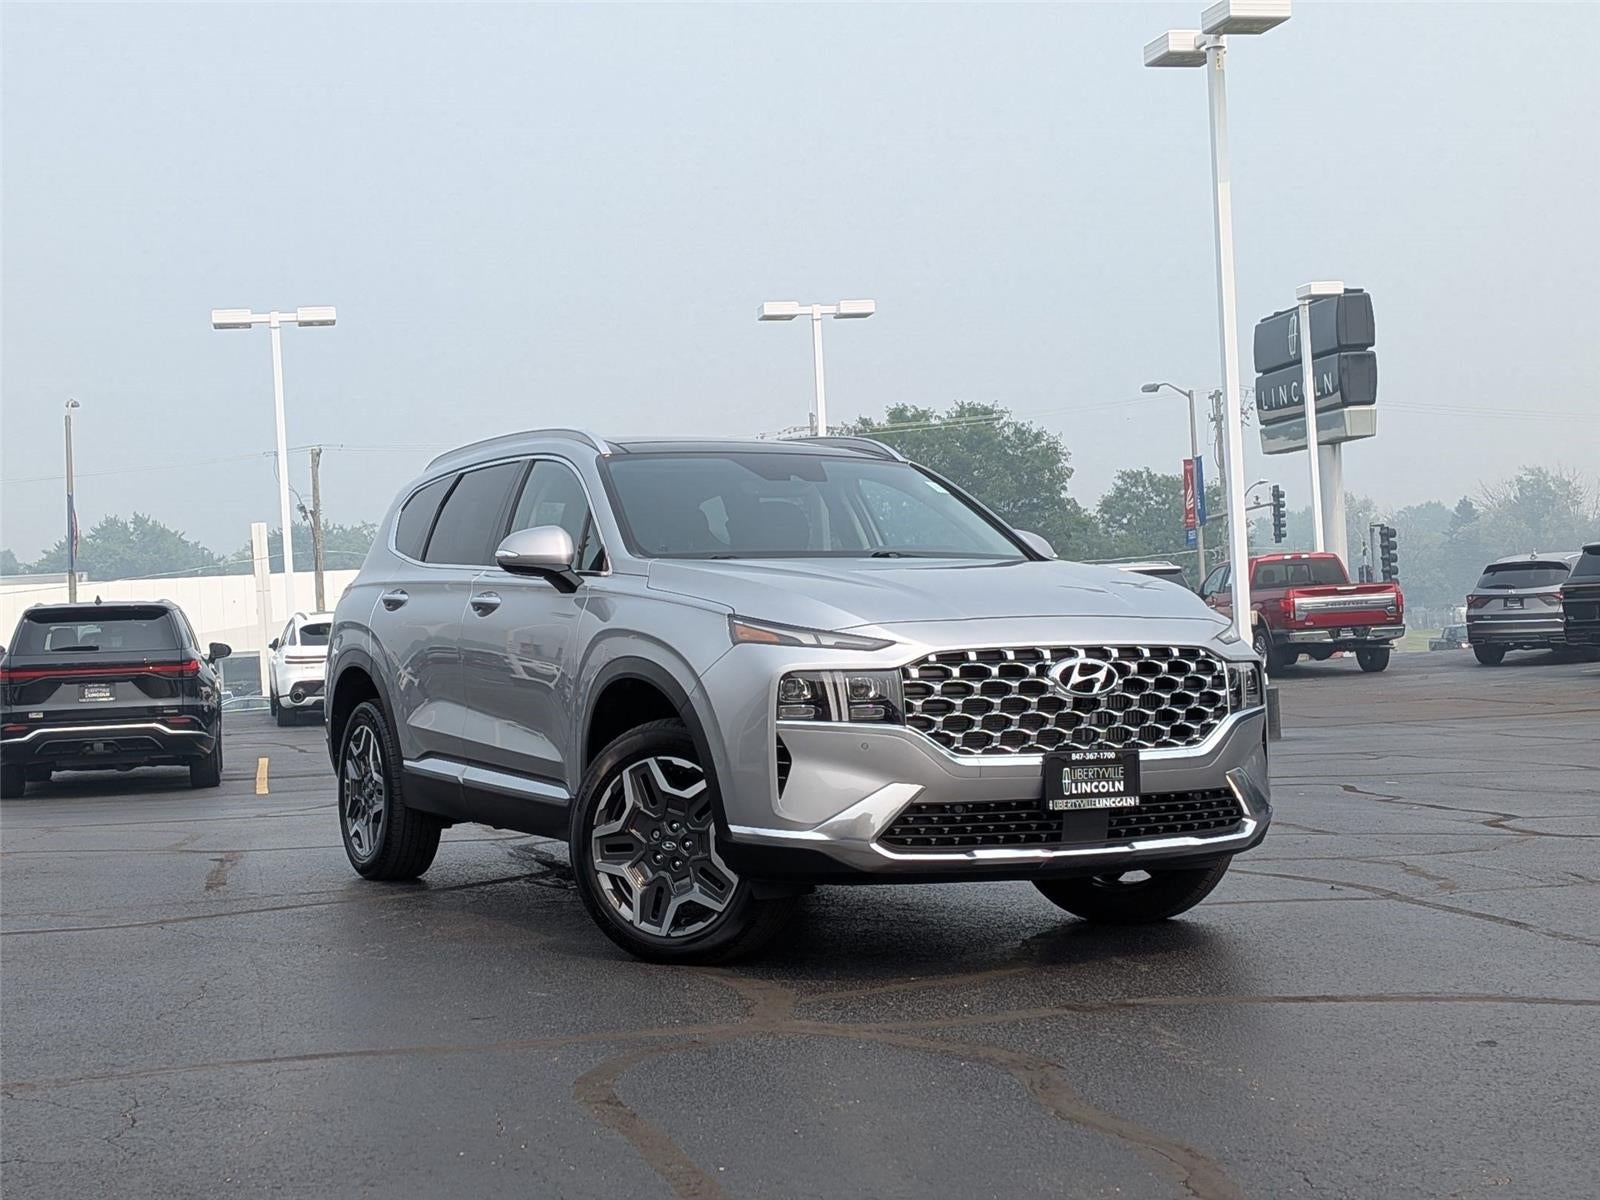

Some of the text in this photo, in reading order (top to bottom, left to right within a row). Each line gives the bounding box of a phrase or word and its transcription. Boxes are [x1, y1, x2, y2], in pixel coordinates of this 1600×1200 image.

[1262, 372, 1333, 410] LINCLN
[1071, 751, 1116, 760] 847-367-1700
[1071, 780, 1124, 794] LINCOLN
